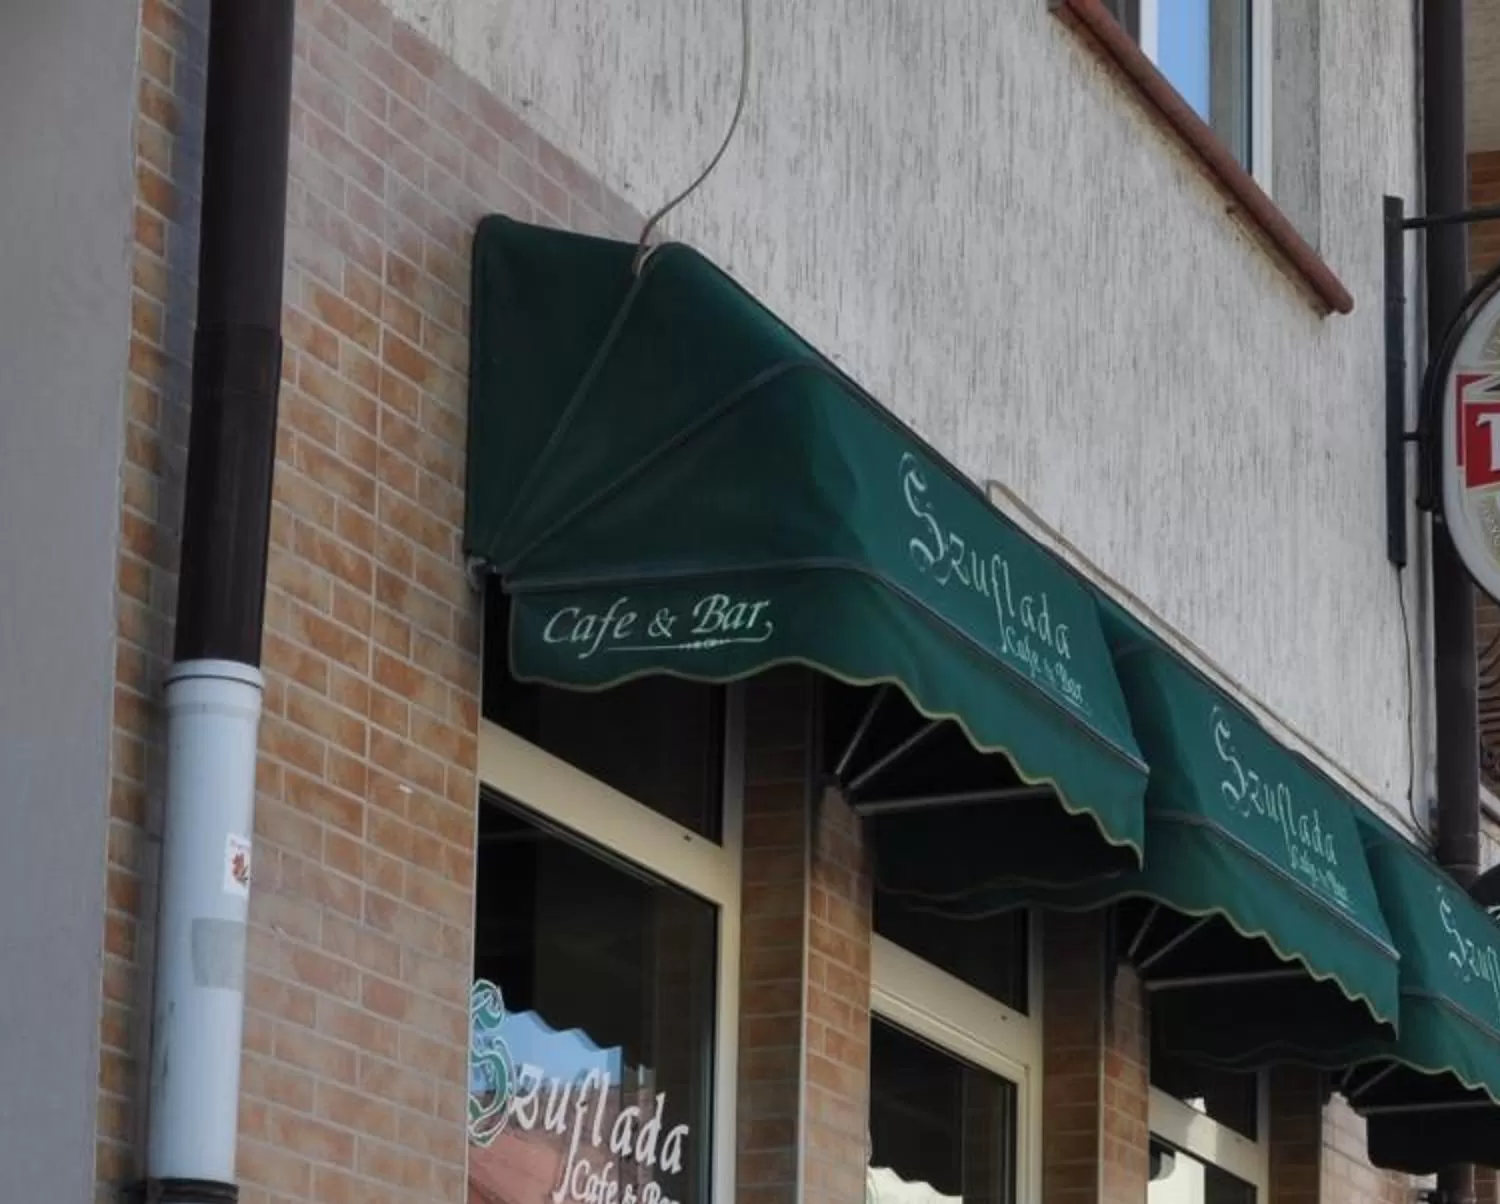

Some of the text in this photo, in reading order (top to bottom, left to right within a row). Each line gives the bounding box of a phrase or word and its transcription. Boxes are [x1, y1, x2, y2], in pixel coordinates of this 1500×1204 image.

[543, 593, 770, 660] Cafe & Bar
[900, 452, 1071, 660] Szuflada
[1211, 706, 1338, 869] Szuflada
